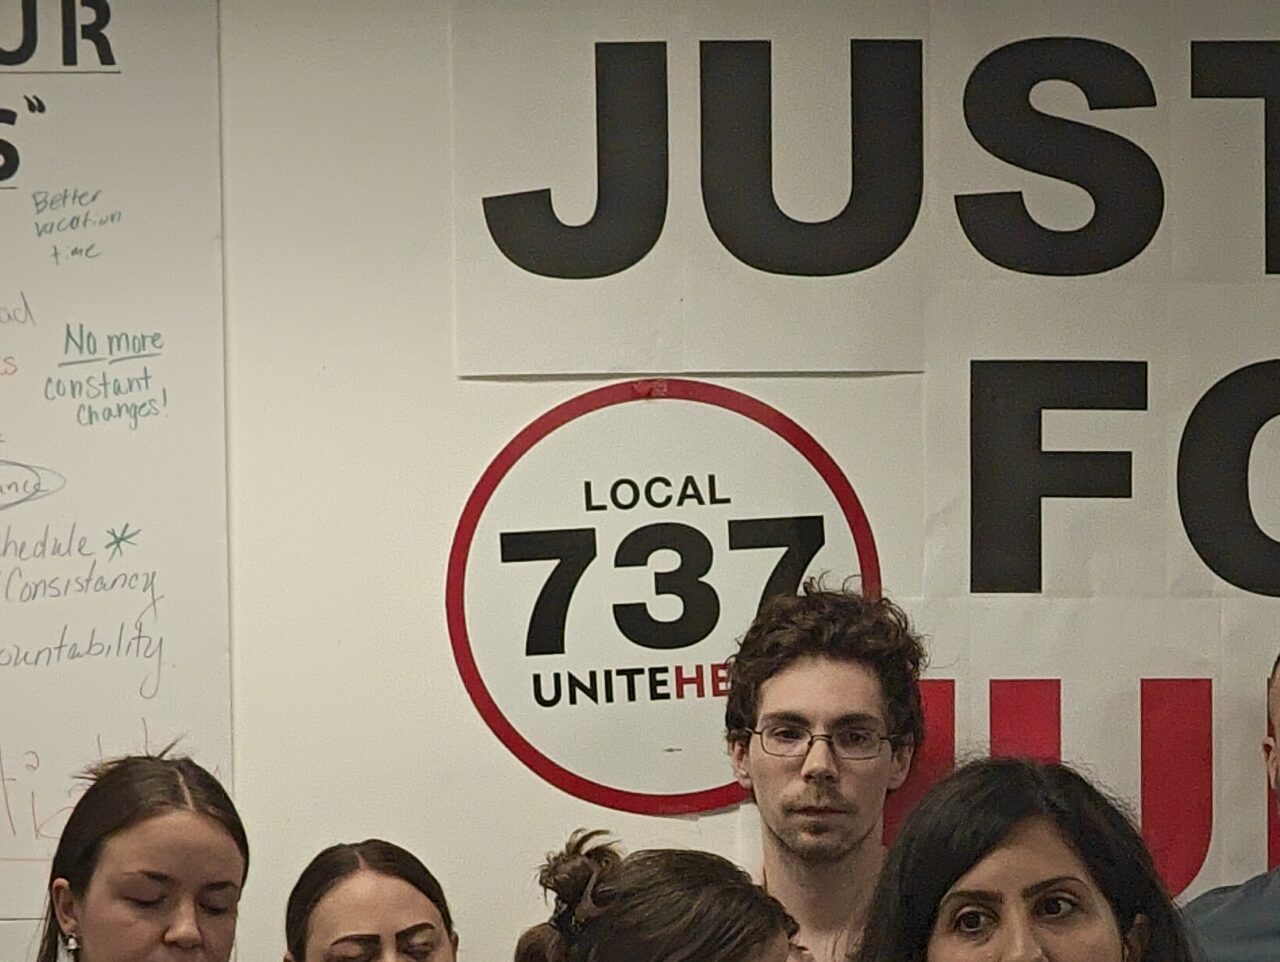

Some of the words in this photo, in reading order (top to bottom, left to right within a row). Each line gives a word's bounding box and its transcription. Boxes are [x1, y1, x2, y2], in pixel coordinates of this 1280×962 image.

[31, 188, 102, 215] Better
[34, 209, 122, 238] vacation
[50, 243, 102, 266] time
[63, 323, 98, 355] No
[106, 332, 164, 356] more
[44, 366, 153, 400] constant
[76, 386, 169, 431] changes!
[584, 474, 732, 512] LOCAL
[5, 559, 165, 622] Consistancy
[499, 515, 826, 657] 737
